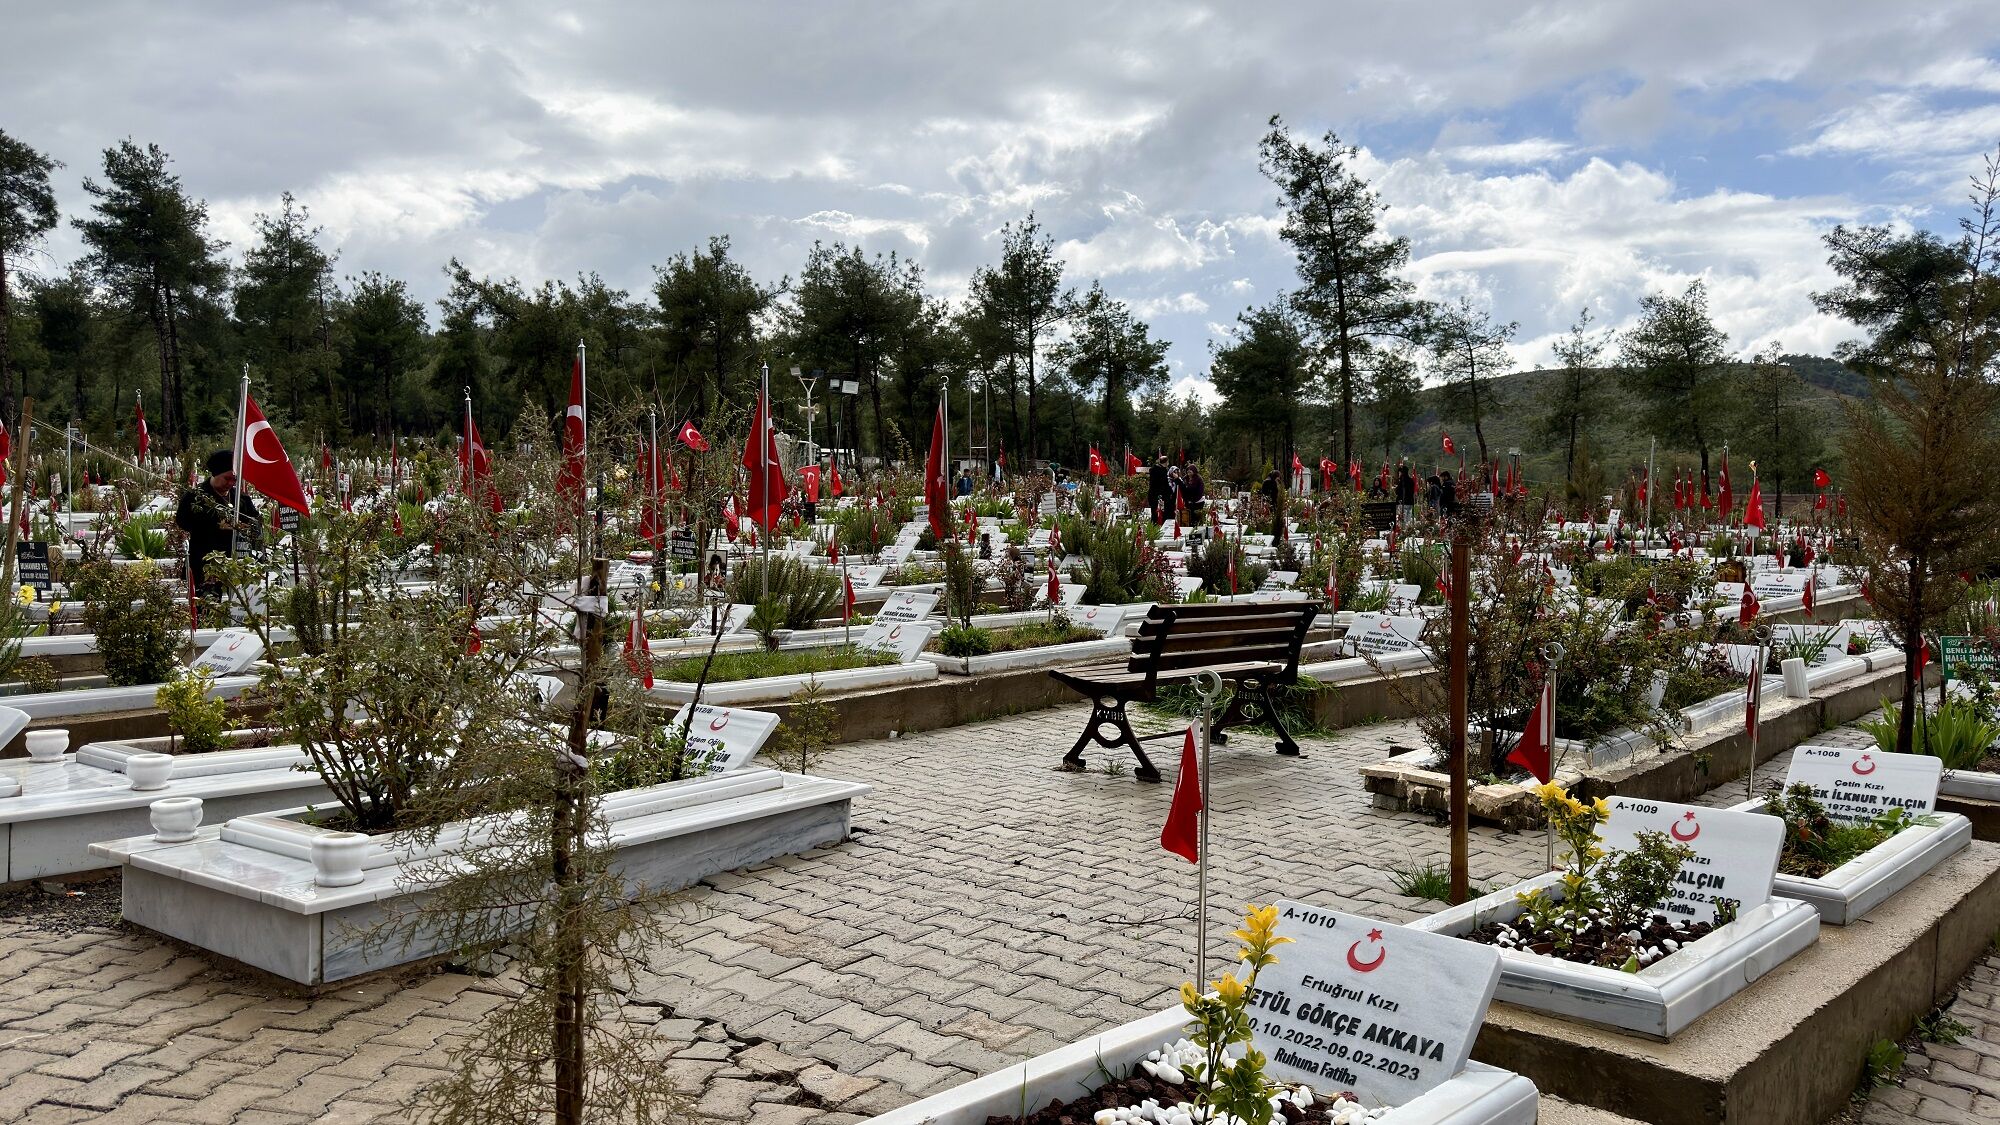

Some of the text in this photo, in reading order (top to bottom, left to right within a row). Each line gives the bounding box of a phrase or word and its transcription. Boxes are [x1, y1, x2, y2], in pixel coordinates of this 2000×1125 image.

[1805, 749, 1840, 758] A-1008
[1834, 779, 1884, 791] Çetin Kızı
[1616, 801, 1658, 814] A-1009
[1831, 789, 1877, 804] İLKNUR
[1881, 796, 1927, 810] YALÇIN
[1676, 870, 1725, 889] ALÇIN
[1283, 907, 1336, 929] A-1010
[1666, 901, 1696, 916] Fatiha
[1301, 974, 1399, 1013] Ertuğrul Kızı
[1242, 985, 1445, 1063] ETÜL GÖKÇE AKKAYA
[1247, 1017, 1420, 1081] 0.10.2022-09.02.2023
[1274, 1047, 1358, 1086] Ruhuna Fatiha
